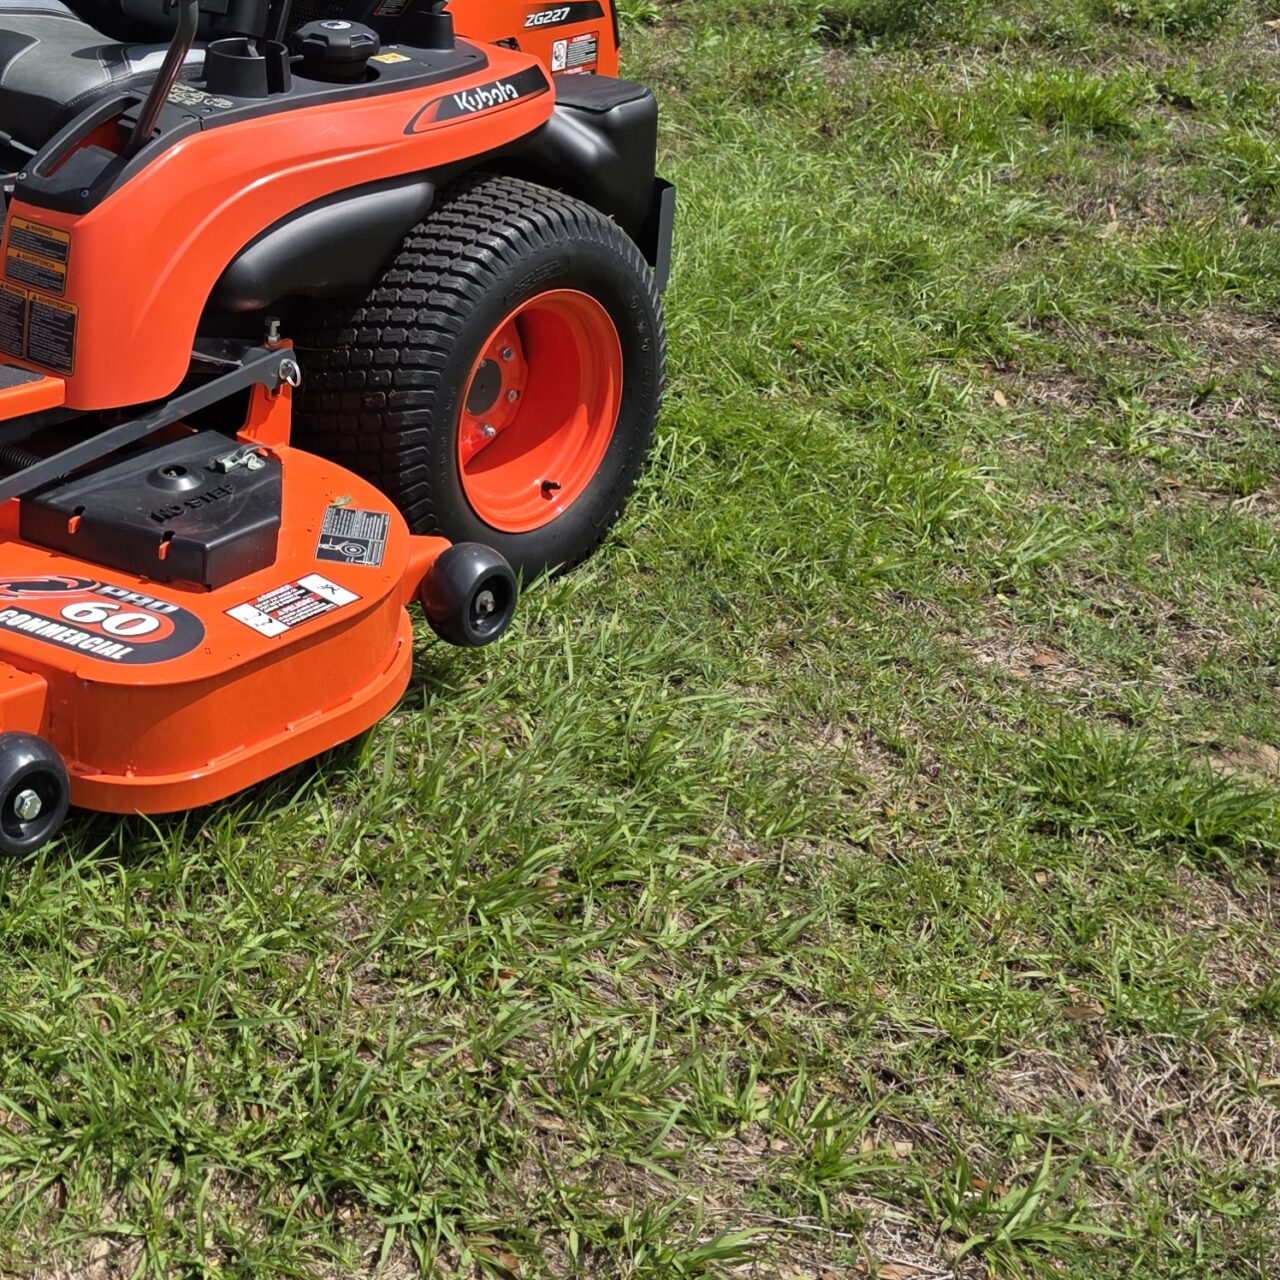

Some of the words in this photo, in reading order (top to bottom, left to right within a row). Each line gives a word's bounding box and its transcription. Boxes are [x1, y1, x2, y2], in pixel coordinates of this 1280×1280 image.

[524, 7, 570, 27] ZG227
[453, 81, 519, 112] Kubota
[95, 585, 180, 614] PRO
[61, 601, 161, 636] 60
